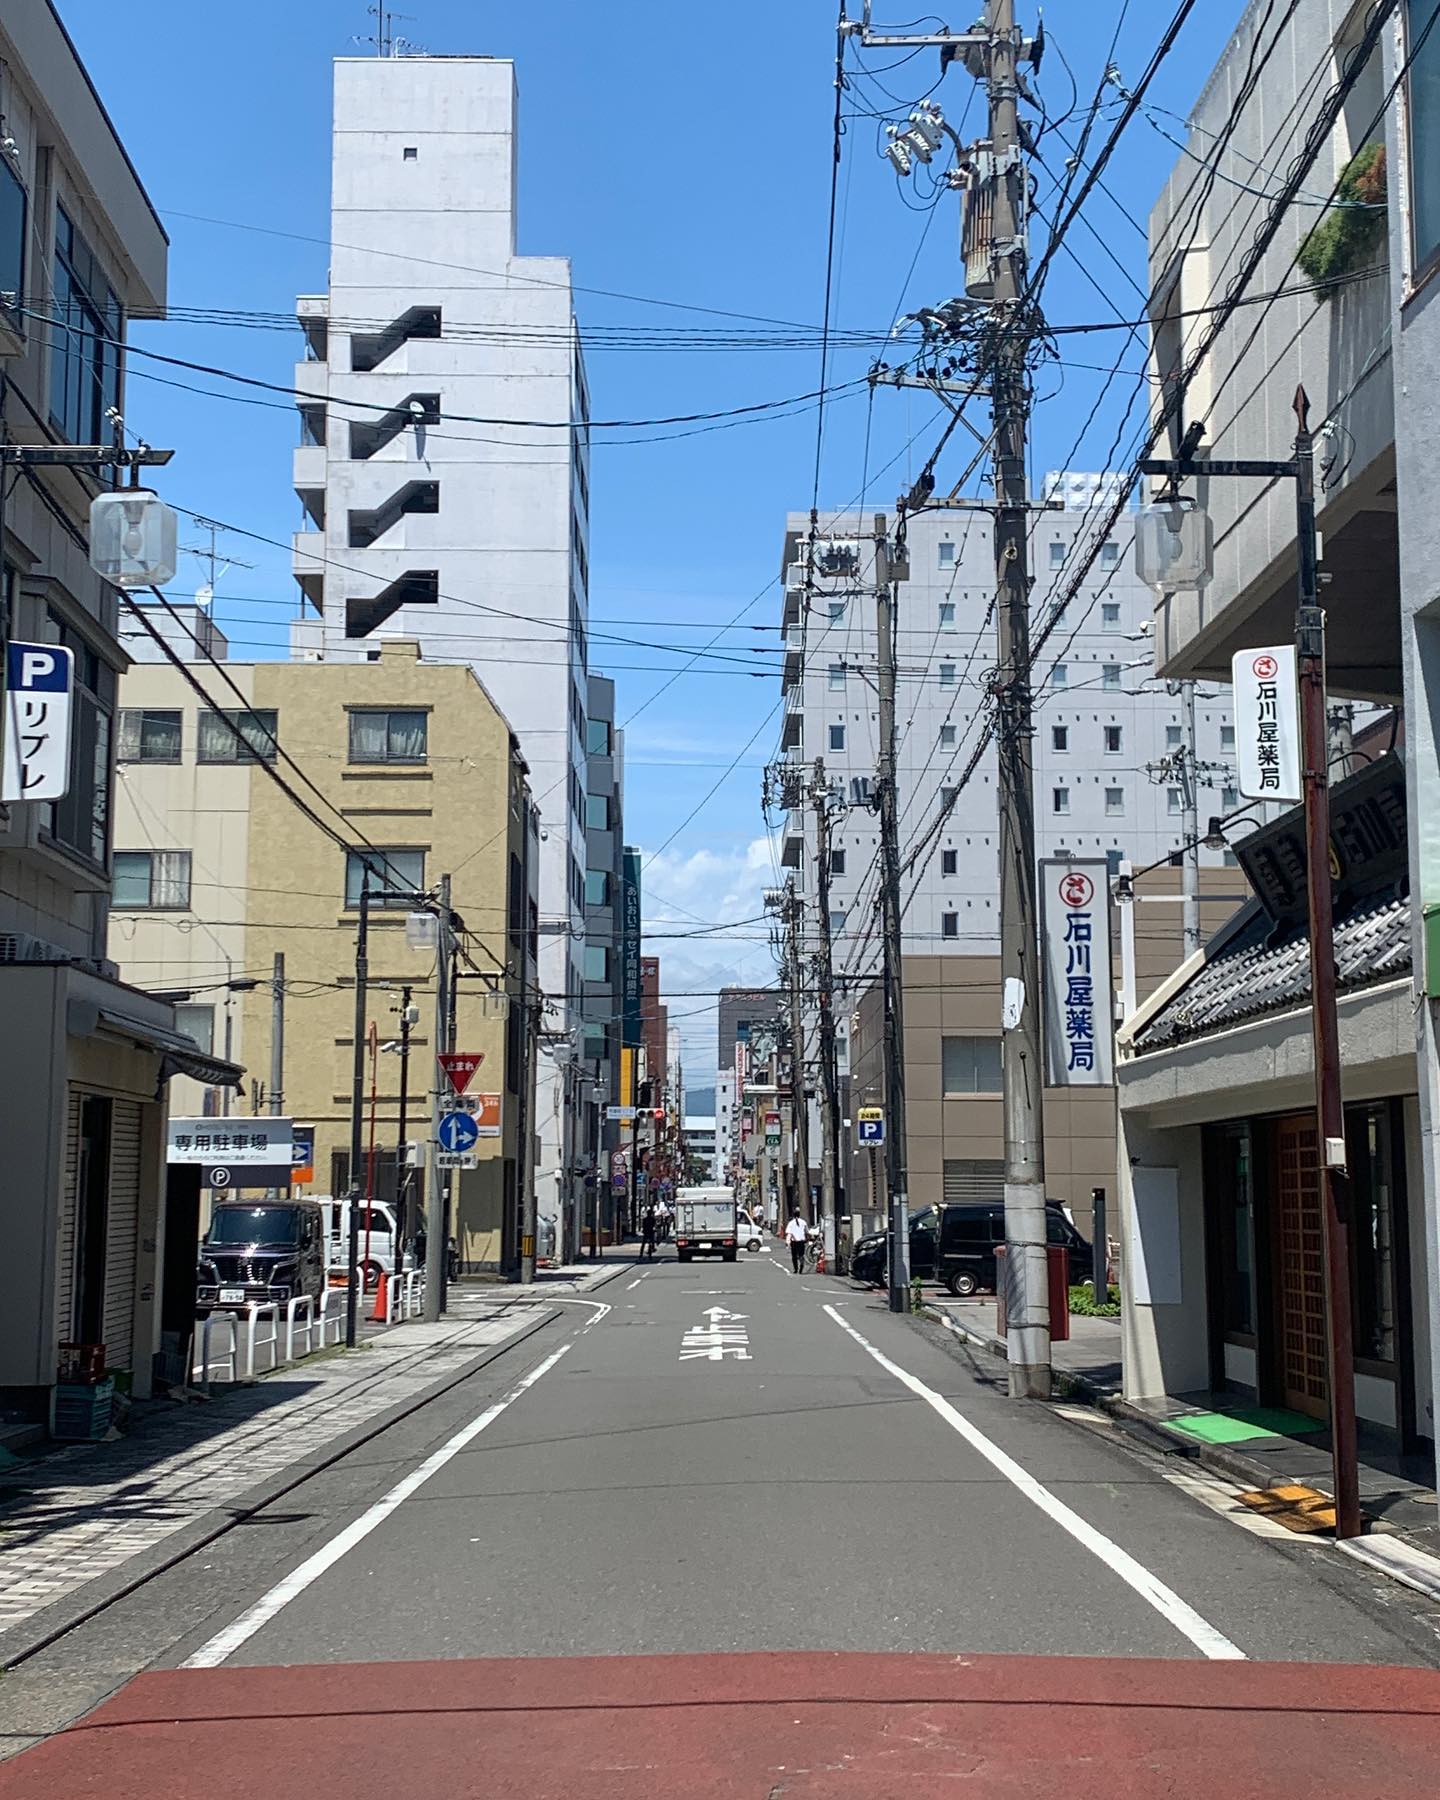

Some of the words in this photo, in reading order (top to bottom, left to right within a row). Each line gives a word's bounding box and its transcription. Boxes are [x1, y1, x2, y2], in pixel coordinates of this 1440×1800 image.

[22, 652, 55, 687] P
[1256, 681, 1280, 790] 石川屋薬局
[1063, 912, 1094, 1071] 石川屋薬局
[446, 1061, 474, 1071] 止まれ
[175, 1134, 269, 1151] 専用駐車場
[864, 1122, 877, 1137] P
